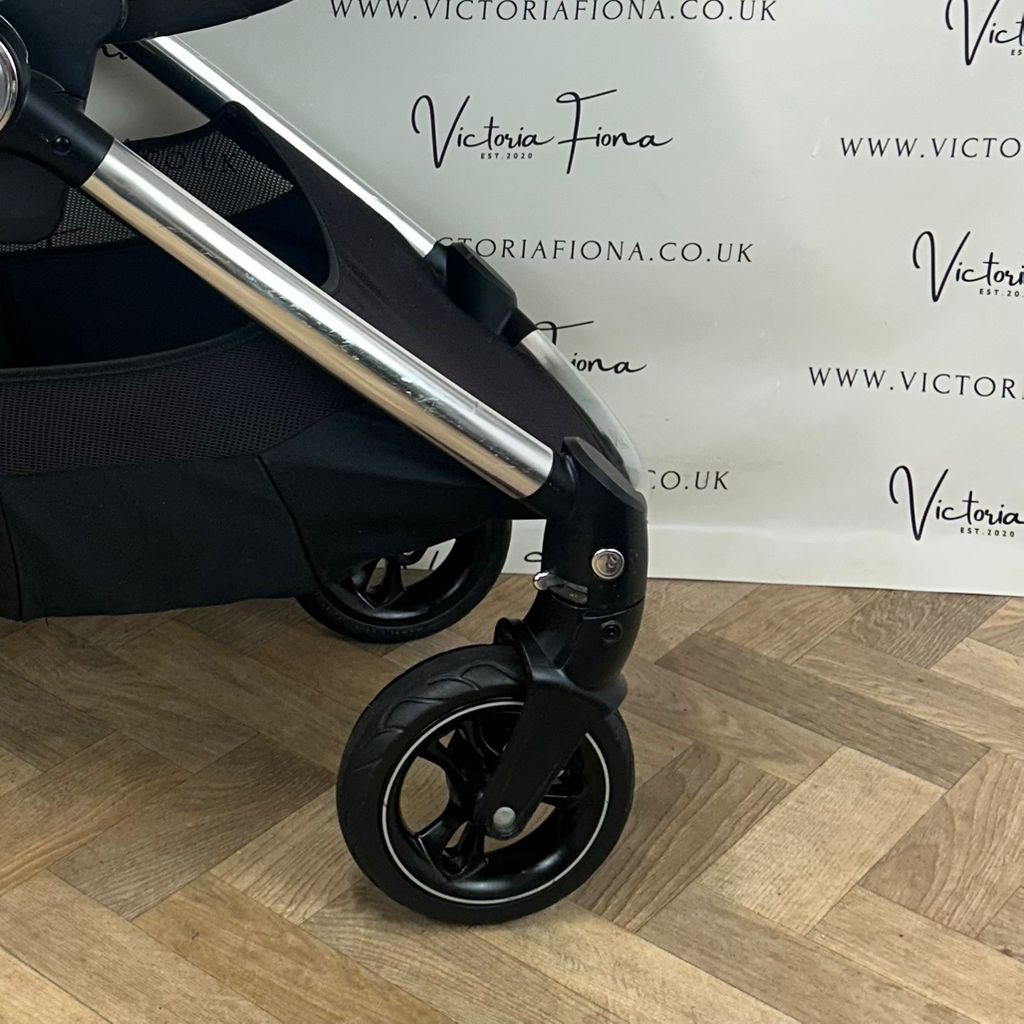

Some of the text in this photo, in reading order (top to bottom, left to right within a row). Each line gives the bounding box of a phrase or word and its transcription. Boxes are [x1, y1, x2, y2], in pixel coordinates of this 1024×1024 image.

[411, 89, 673, 174] Victoria Fiona
[480, 152, 534, 160] EST.2020
[979, 288, 1024, 297] EST.20
[809, 367, 1024, 400] WWW.VICTOR
[889, 465, 1024, 541] Victoria
[959, 527, 1015, 538] EST.2020
